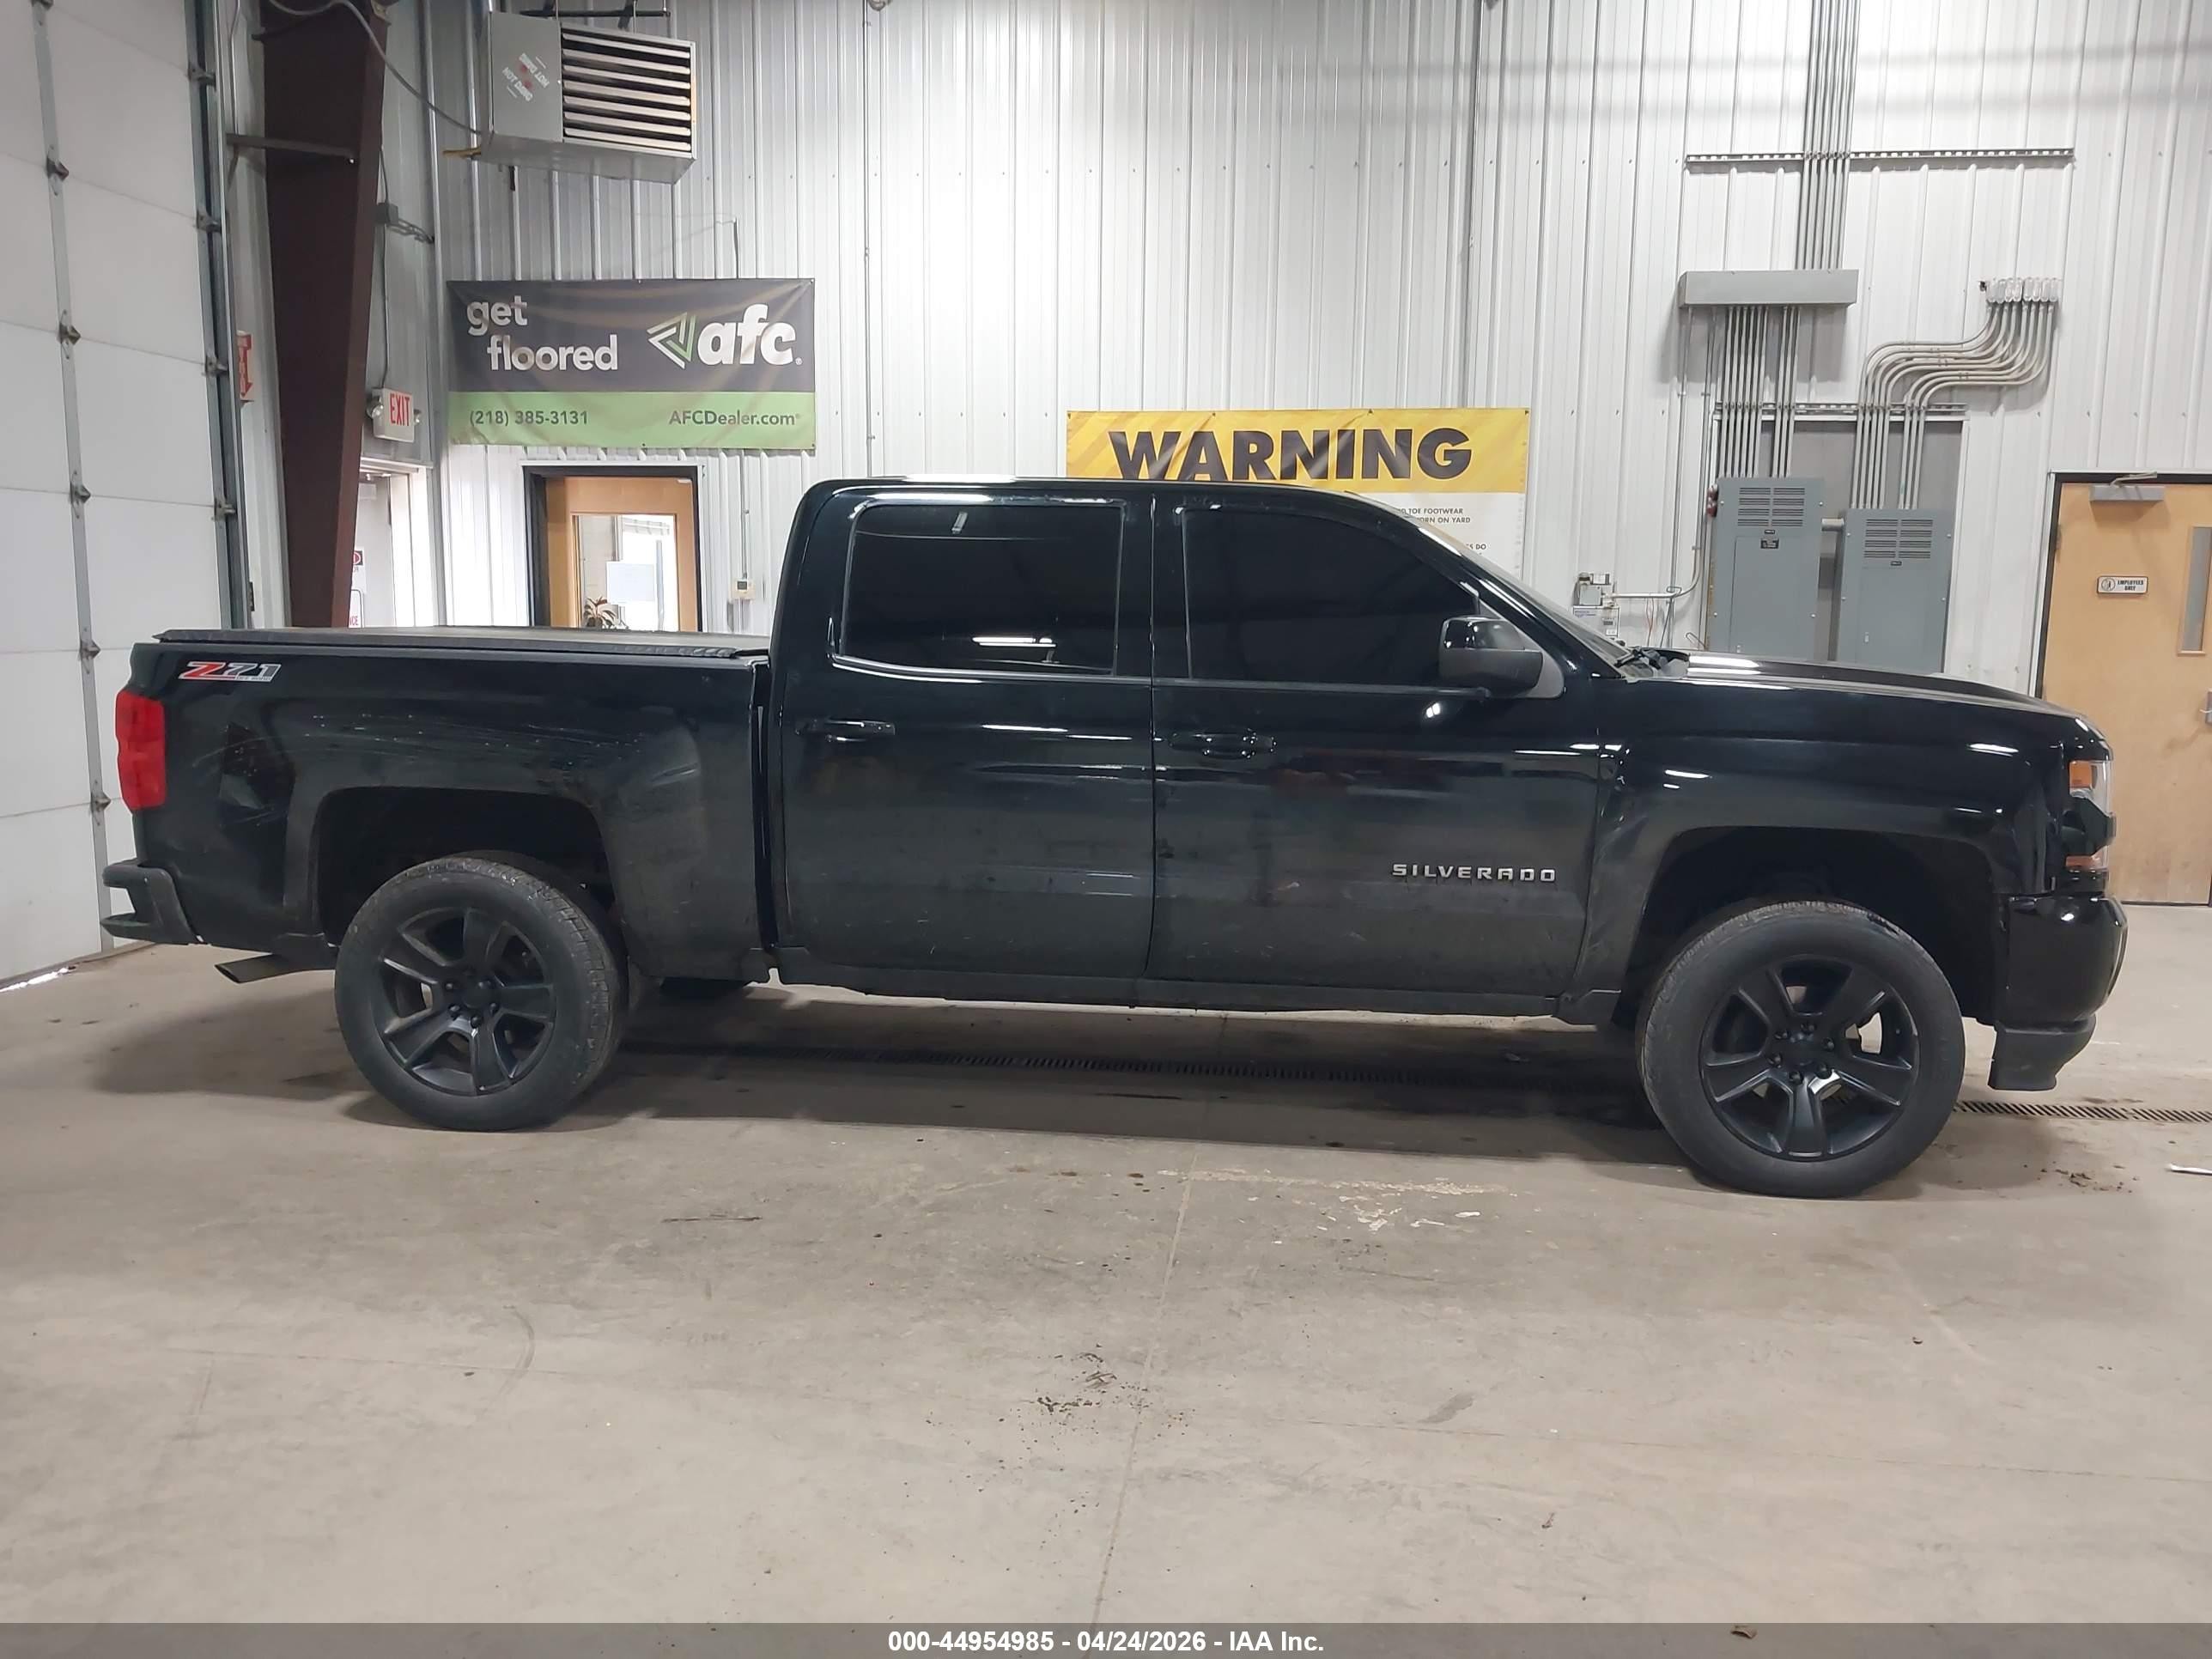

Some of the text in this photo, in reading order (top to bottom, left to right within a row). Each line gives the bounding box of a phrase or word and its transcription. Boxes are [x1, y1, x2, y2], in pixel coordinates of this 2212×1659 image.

[466, 295, 527, 336] get
[487, 334, 618, 371] floored
[697, 304, 796, 366] afc
[390, 392, 410, 427] EXIT
[470, 410, 588, 426] (218) 385-3131
[669, 410, 795, 426] AFCDealer.com
[1108, 428, 1472, 481] WARNING
[179, 661, 282, 682] Z71
[1393, 864, 1555, 882] SILVERADO
